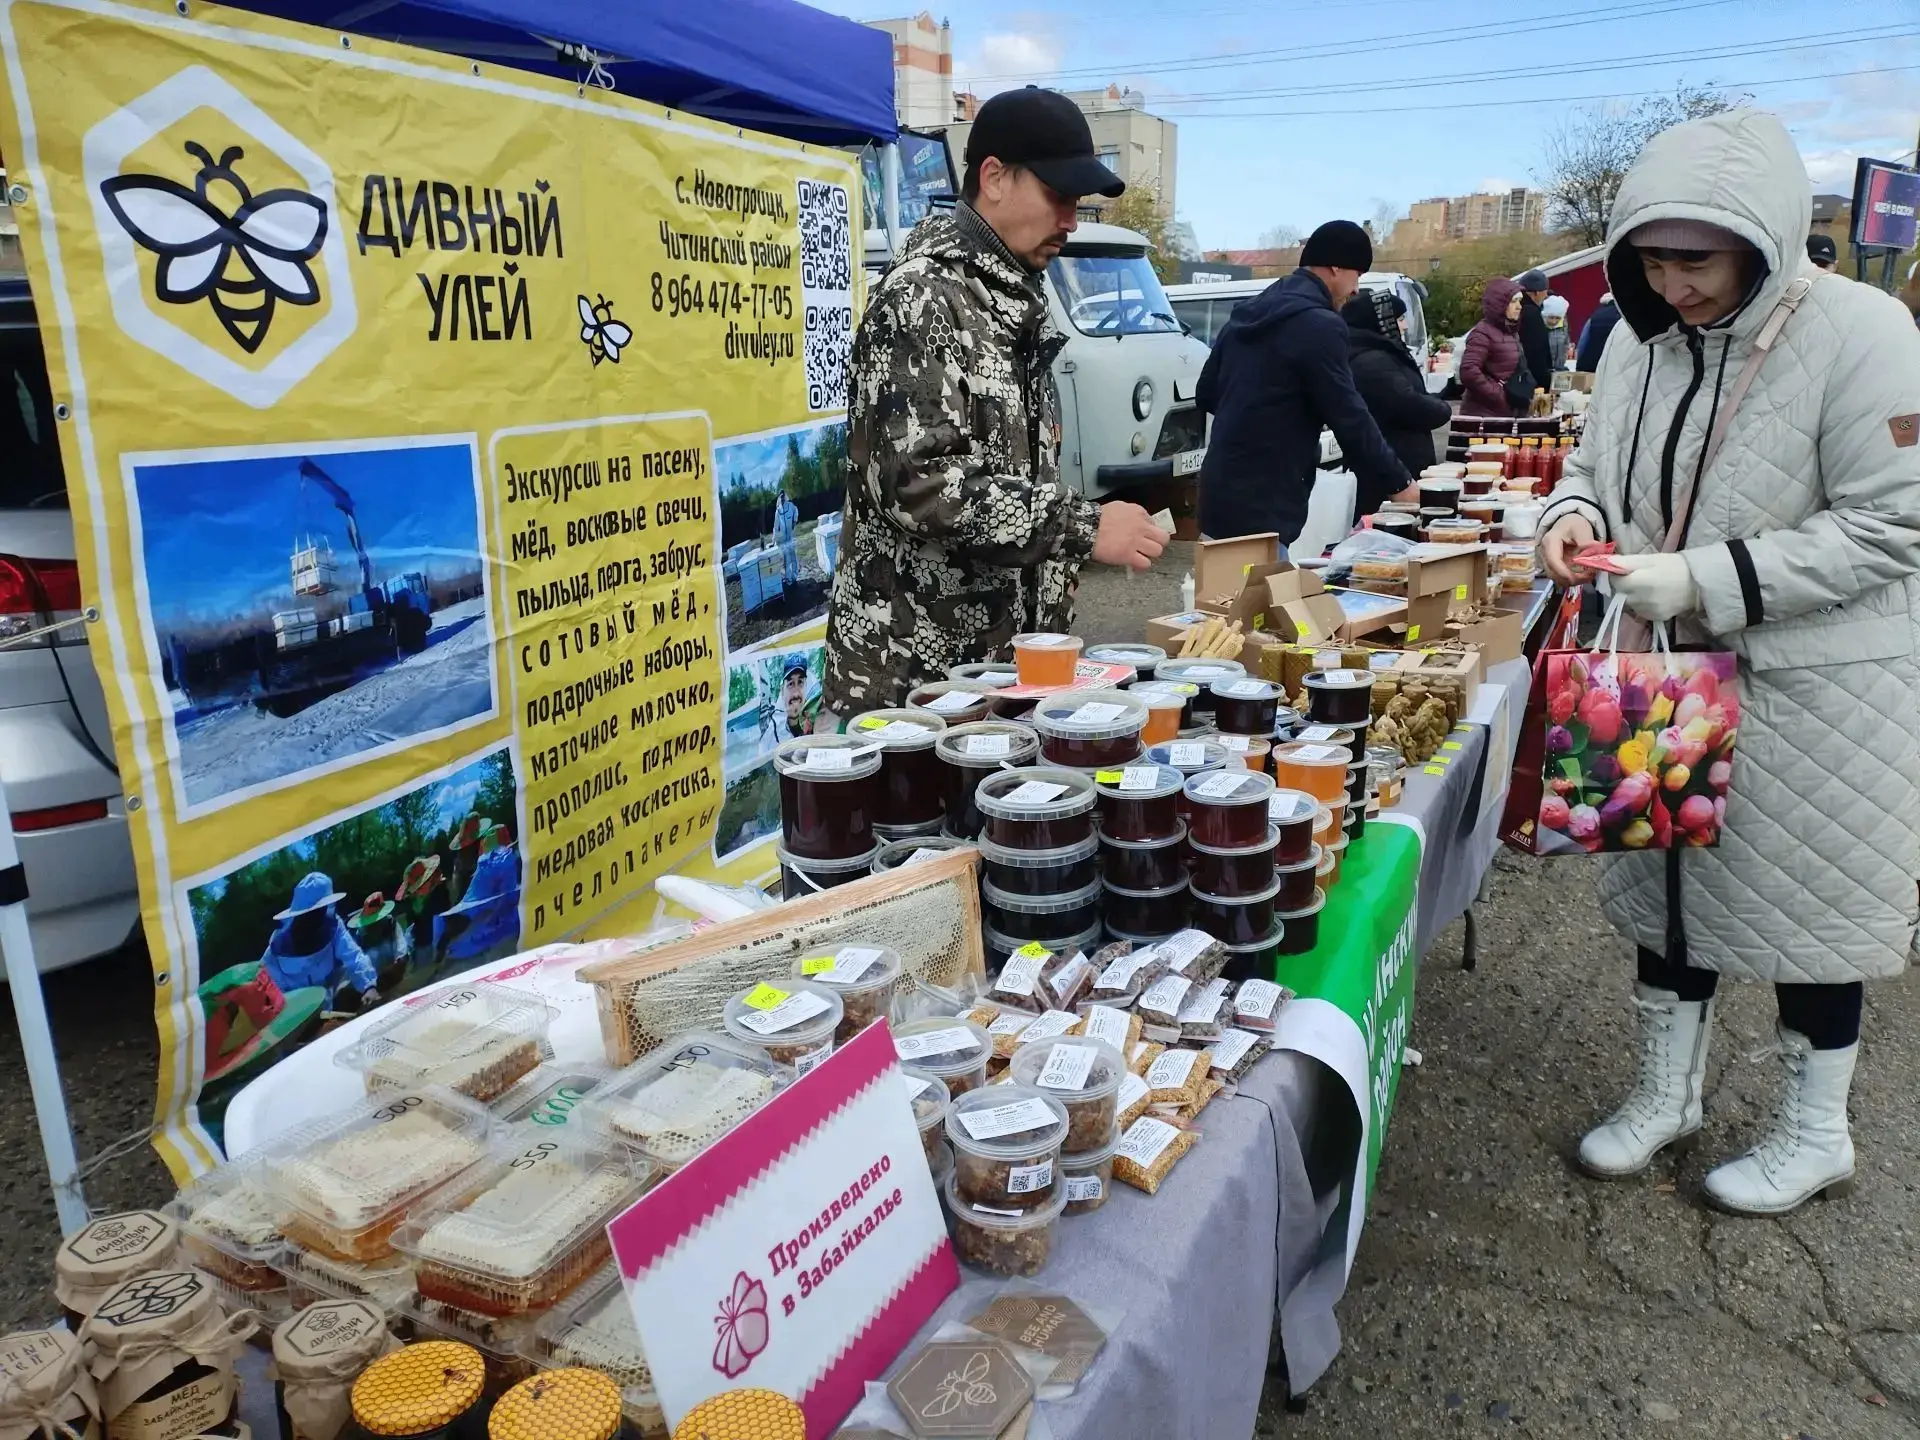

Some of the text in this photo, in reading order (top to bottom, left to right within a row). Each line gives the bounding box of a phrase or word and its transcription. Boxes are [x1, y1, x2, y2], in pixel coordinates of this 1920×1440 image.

[356, 174, 563, 258] ДИВНЫЙ
[675, 168, 789, 225] с. Новотроицк,
[659, 220, 792, 275] Читинский район
[416, 260, 532, 341] УЛЕЙ
[650, 271, 793, 321] 8 964 474-77-05
[724, 320, 794, 367] divuley.ru
[504, 447, 706, 505] Экскурсии на пасеку,
[511, 496, 708, 562] мёд, восковые свечи,
[516, 538, 706, 619] пыльца, перга, забрус,
[521, 588, 709, 674] сотовый мёд,
[526, 634, 714, 728] подарочные наборы,
[530, 680, 715, 782] маточное молочко,
[533, 724, 717, 836] прополис, подмор,
[536, 765, 717, 884] медовая косметика,
[533, 804, 716, 933] пчелопакеты
[436, 990, 477, 1011] 450
[659, 1043, 711, 1073] 450
[372, 1095, 424, 1124] 500
[529, 1086, 584, 1129] 600
[509, 1141, 560, 1172] 550
[95, 1224, 151, 1257] ДИВНЫЙ
[767, 1153, 893, 1278] Произведено
[114, 1234, 150, 1254] УЛЕЙ
[780, 1186, 904, 1318] в Забайкалье
[310, 1316, 363, 1348] ДИВНЫЙ
[1019, 1304, 1057, 1343] BEE AND
[1031, 1311, 1067, 1348] HUMAN
[171, 1384, 200, 1405] МЁД
